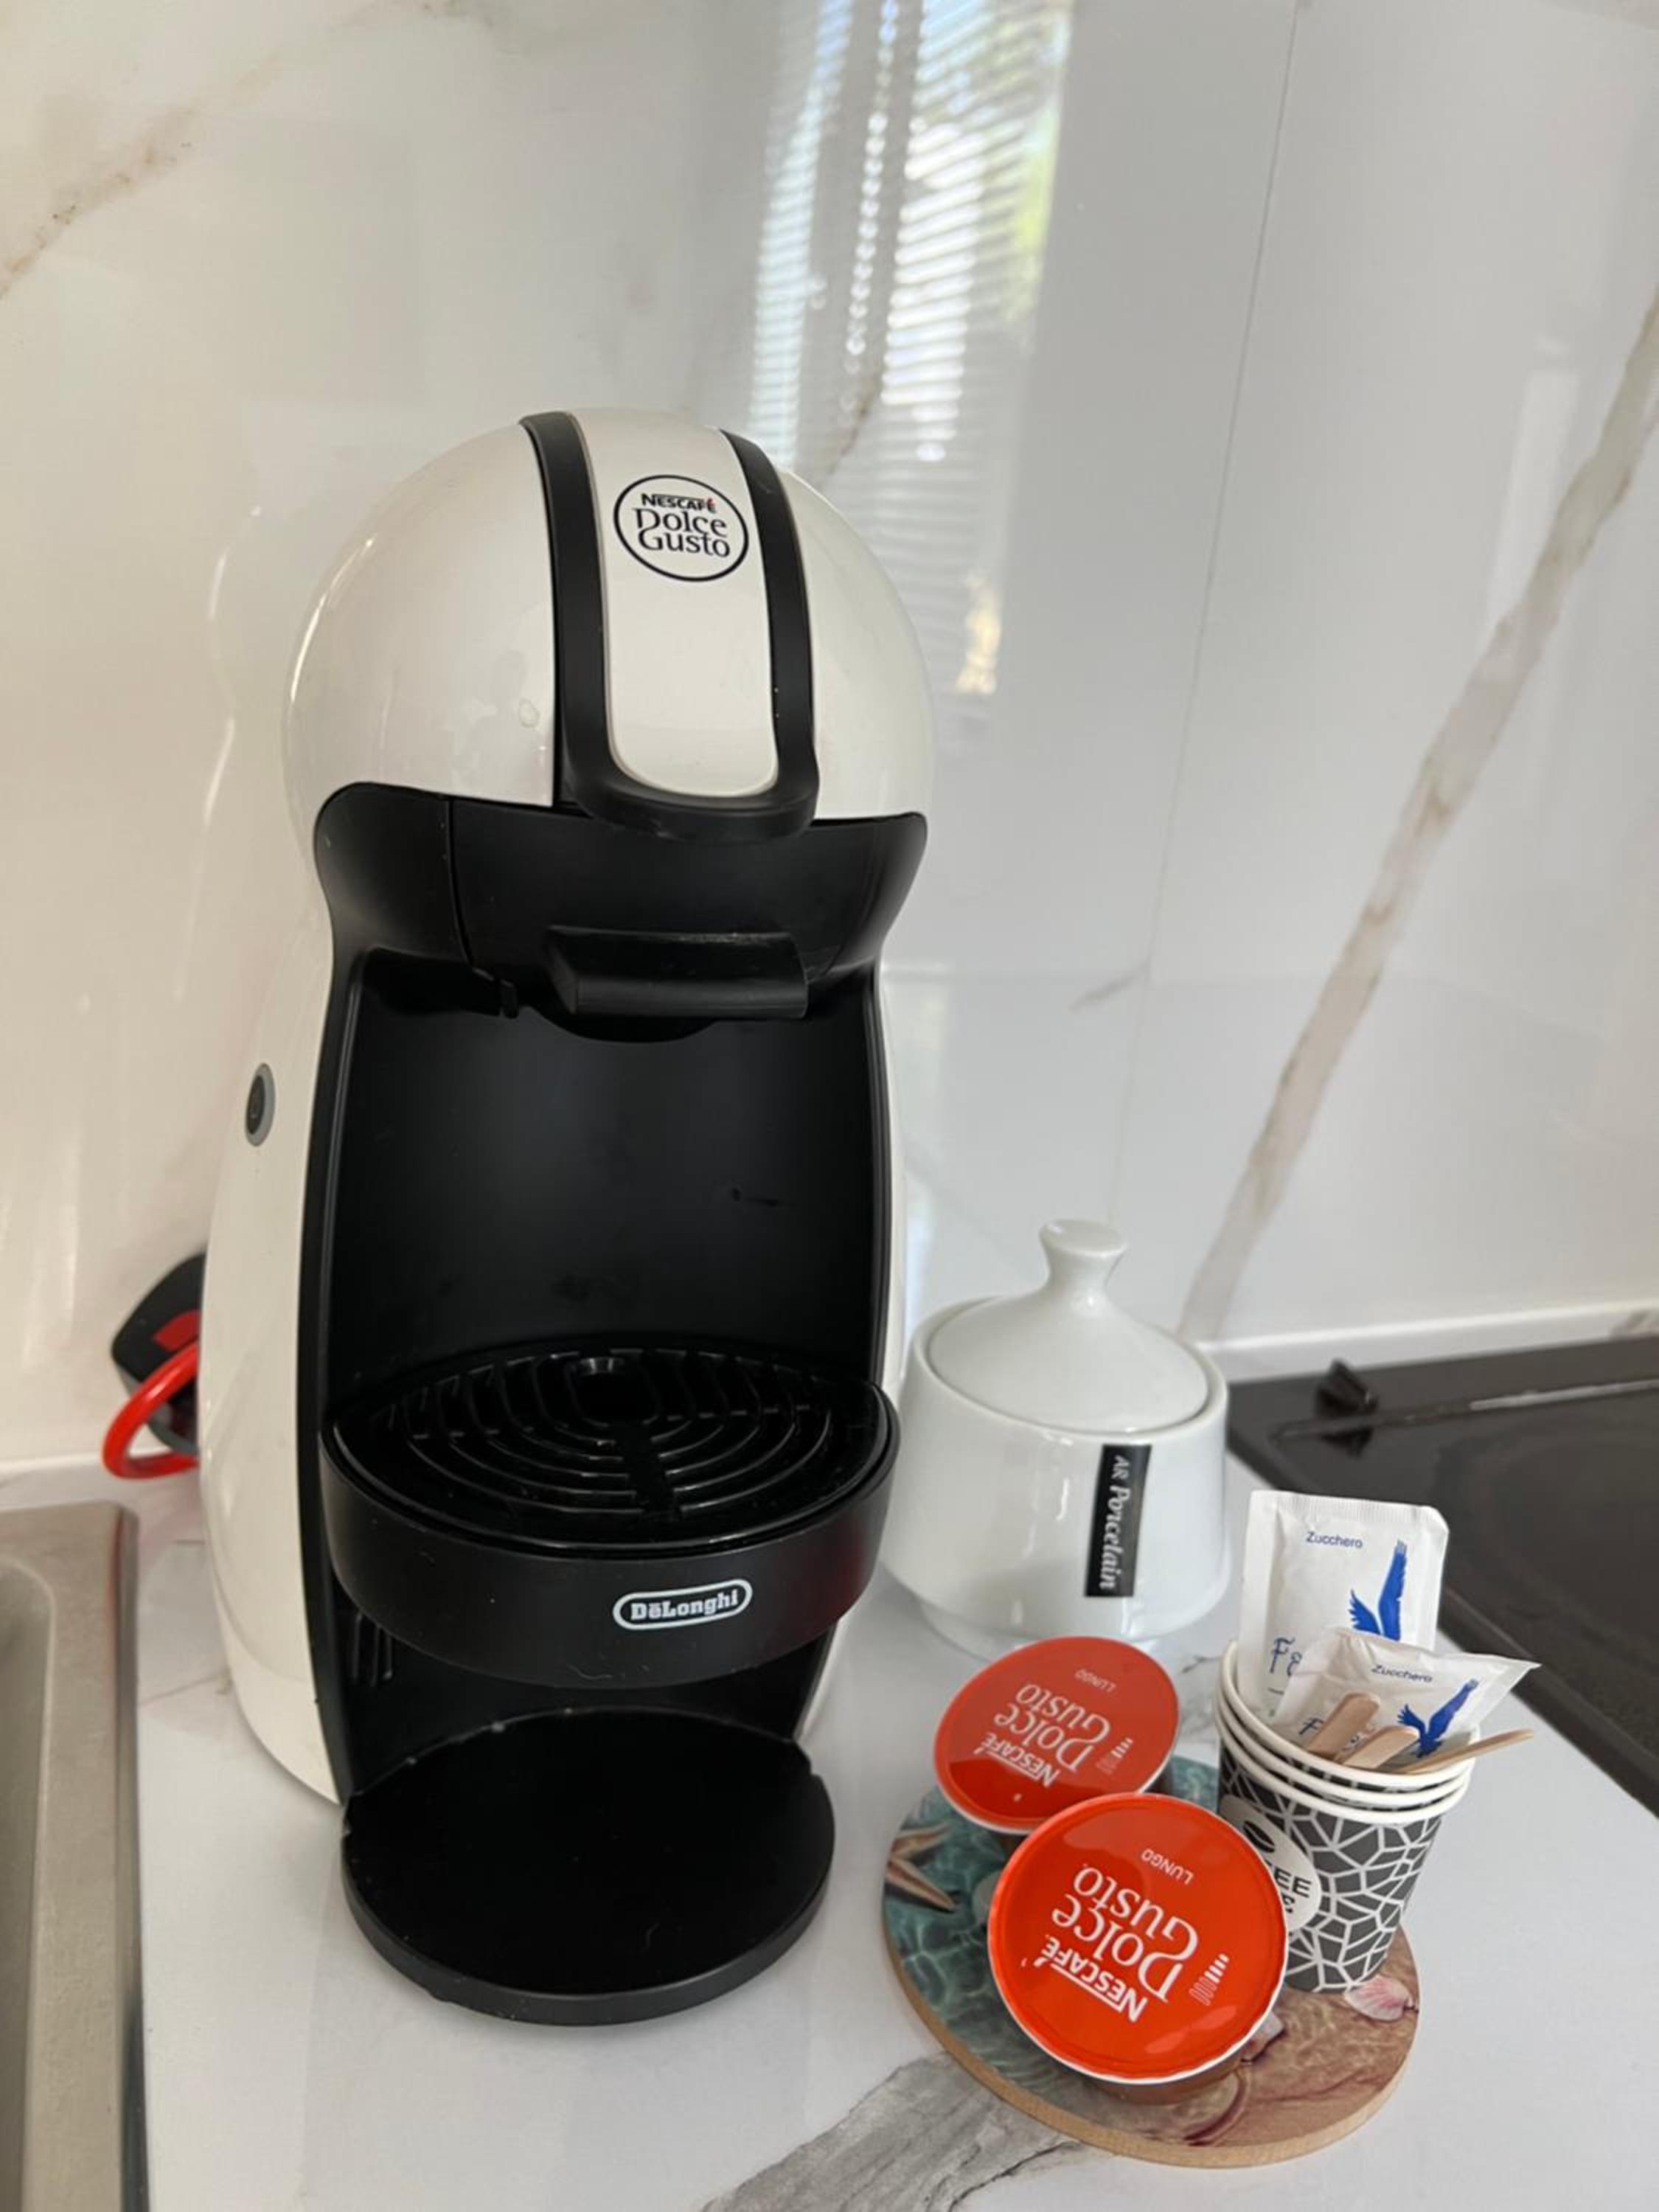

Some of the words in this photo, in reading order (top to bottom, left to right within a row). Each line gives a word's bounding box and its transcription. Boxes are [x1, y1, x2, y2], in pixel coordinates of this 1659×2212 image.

[633, 508, 728, 538] Dolce
[638, 528, 731, 558] Gusto
[1111, 1455, 1131, 1480] AR
[1099, 1486, 1132, 1590] Porcelain
[1306, 1531, 1363, 1549] Zucchero
[1074, 1669, 1117, 1693] LUNGO
[1371, 1663, 1433, 1683] Zucchero
[1015, 1683, 1111, 1745] Gusto
[994, 1703, 1095, 1773] Dolce
[1141, 1848, 1194, 1885] LUNGO
[1073, 1865, 1199, 1961] Gusto
[1051, 1893, 1183, 2003] Dolce
